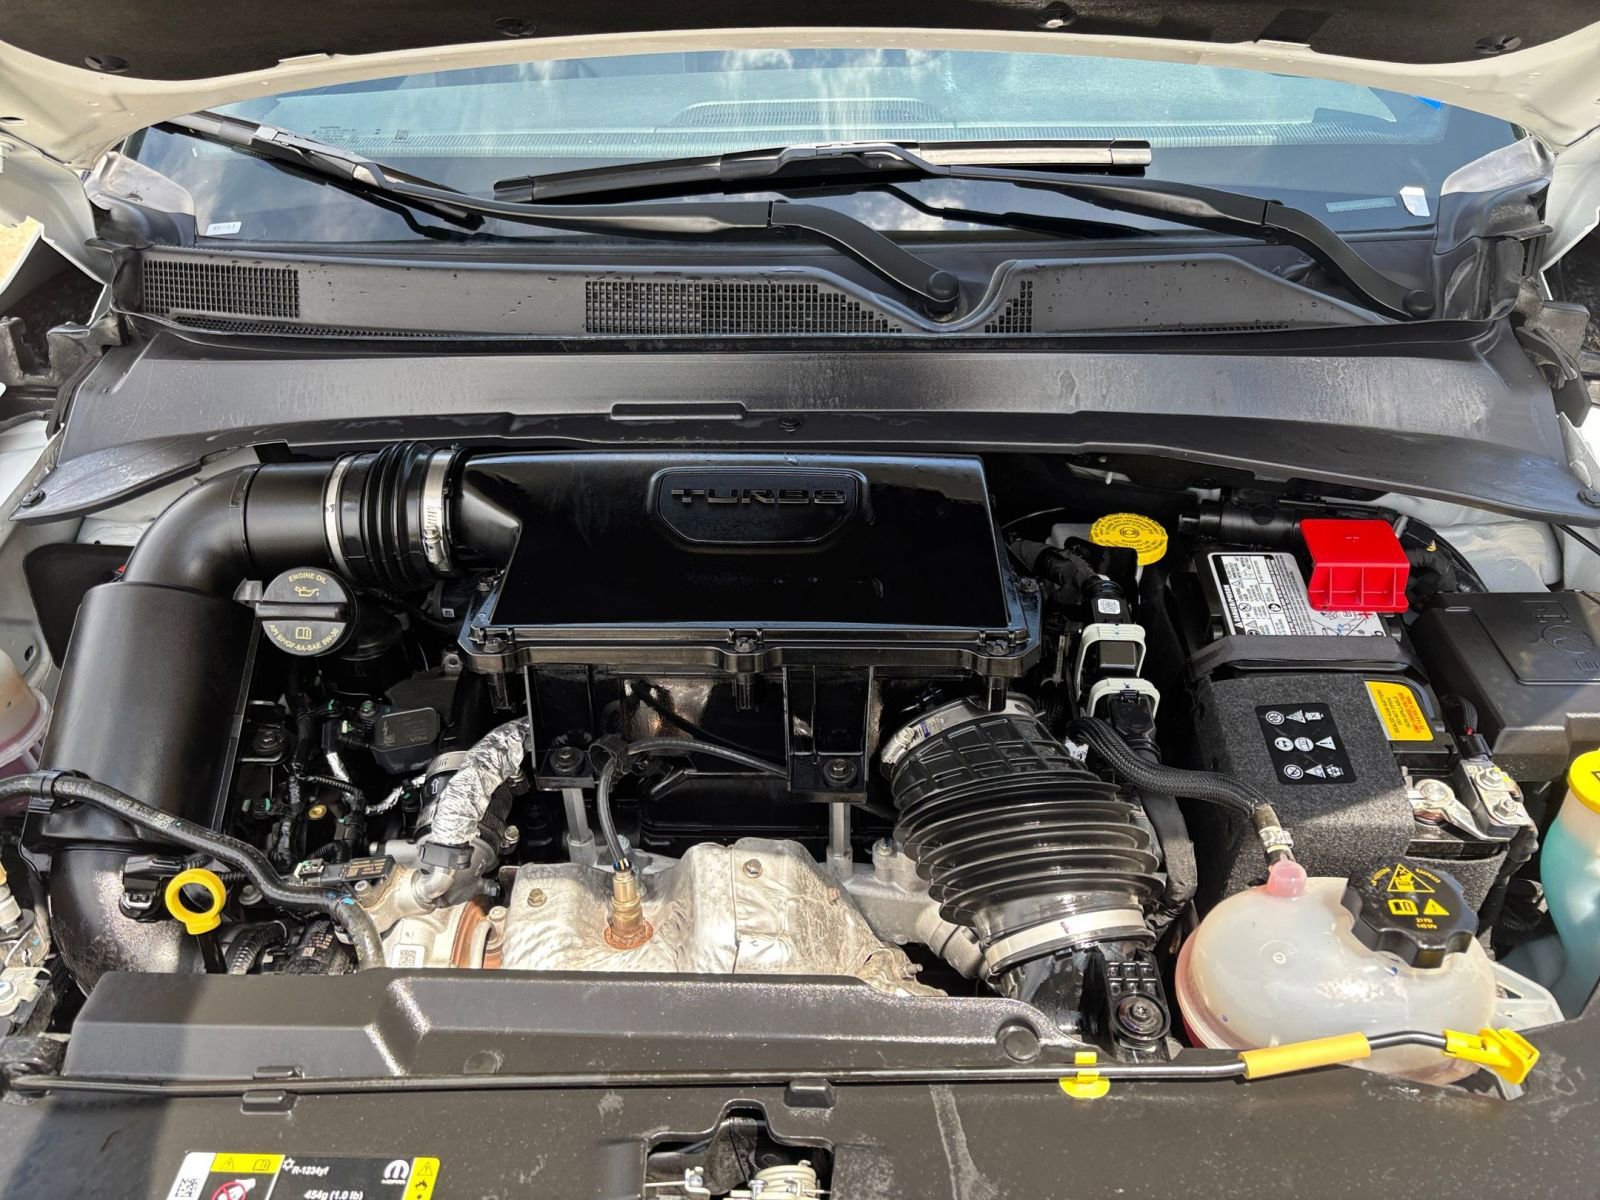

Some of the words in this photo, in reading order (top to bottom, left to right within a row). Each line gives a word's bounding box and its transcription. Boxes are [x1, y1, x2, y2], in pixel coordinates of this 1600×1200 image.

[671, 489, 847, 504] TURBO
[288, 572, 315, 583] ENGINE
[316, 575, 327, 584] OIL
[269, 624, 279, 636] API
[322, 628, 339, 646] 5W-30
[291, 1166, 330, 1177] R-1234yf
[304, 1190, 329, 1200] 454g
[329, 1190, 349, 1200] (1.0
[349, 1190, 364, 1200] lb)
